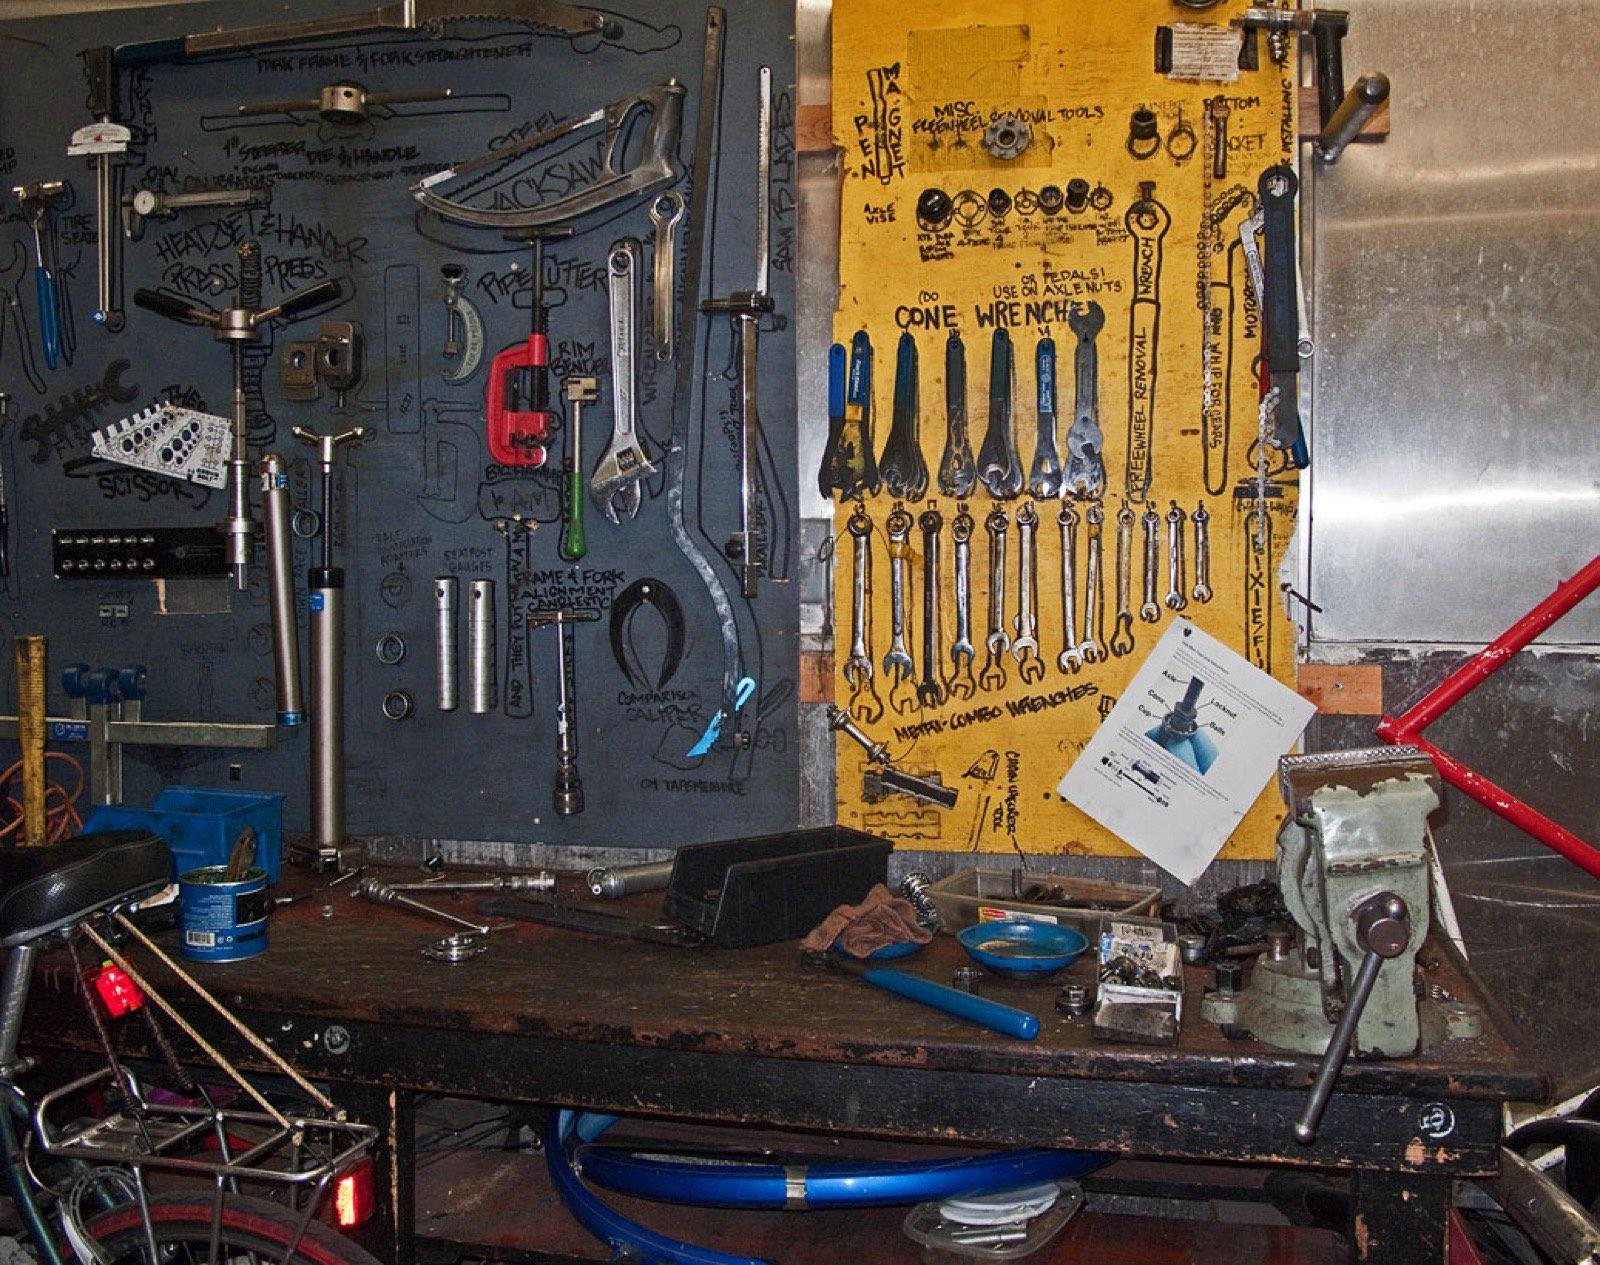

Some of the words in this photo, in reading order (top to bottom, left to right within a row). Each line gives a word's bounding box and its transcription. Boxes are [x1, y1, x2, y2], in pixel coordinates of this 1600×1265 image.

[370, 50, 415, 67] FORK
[934, 101, 980, 118] MISC.
[1058, 105, 1104, 120] TOOLS
[864, 202, 895, 214] AXLE
[866, 214, 896, 224] VISE
[264, 255, 329, 294] PRESS
[1021, 273, 1037, 285] OR
[1043, 267, 1106, 284] PEDALS!
[1138, 236, 1155, 297] WRENCH
[162, 262, 239, 297] PRESS
[477, 267, 533, 304] PIPE
[993, 286, 1019, 300] USE
[1021, 285, 1038, 298] ON
[1043, 283, 1083, 297] AXLE
[895, 303, 959, 331] CONE
[558, 341, 595, 357] RIM
[1135, 327, 1147, 399] REMOVAL
[1210, 342, 1223, 378] WHIP
[1210, 382, 1223, 407] FOR
[583, 569, 626, 584] FORK
[521, 585, 617, 600] ALIGNMENT
[510, 636, 524, 672] THEY
[1162, 669, 1177, 682] Axle
[511, 678, 524, 709] AND
[1006, 682, 1099, 719] WRENCHES
[1138, 704, 1152, 717] Cup
[1211, 697, 1237, 720] Locknut
